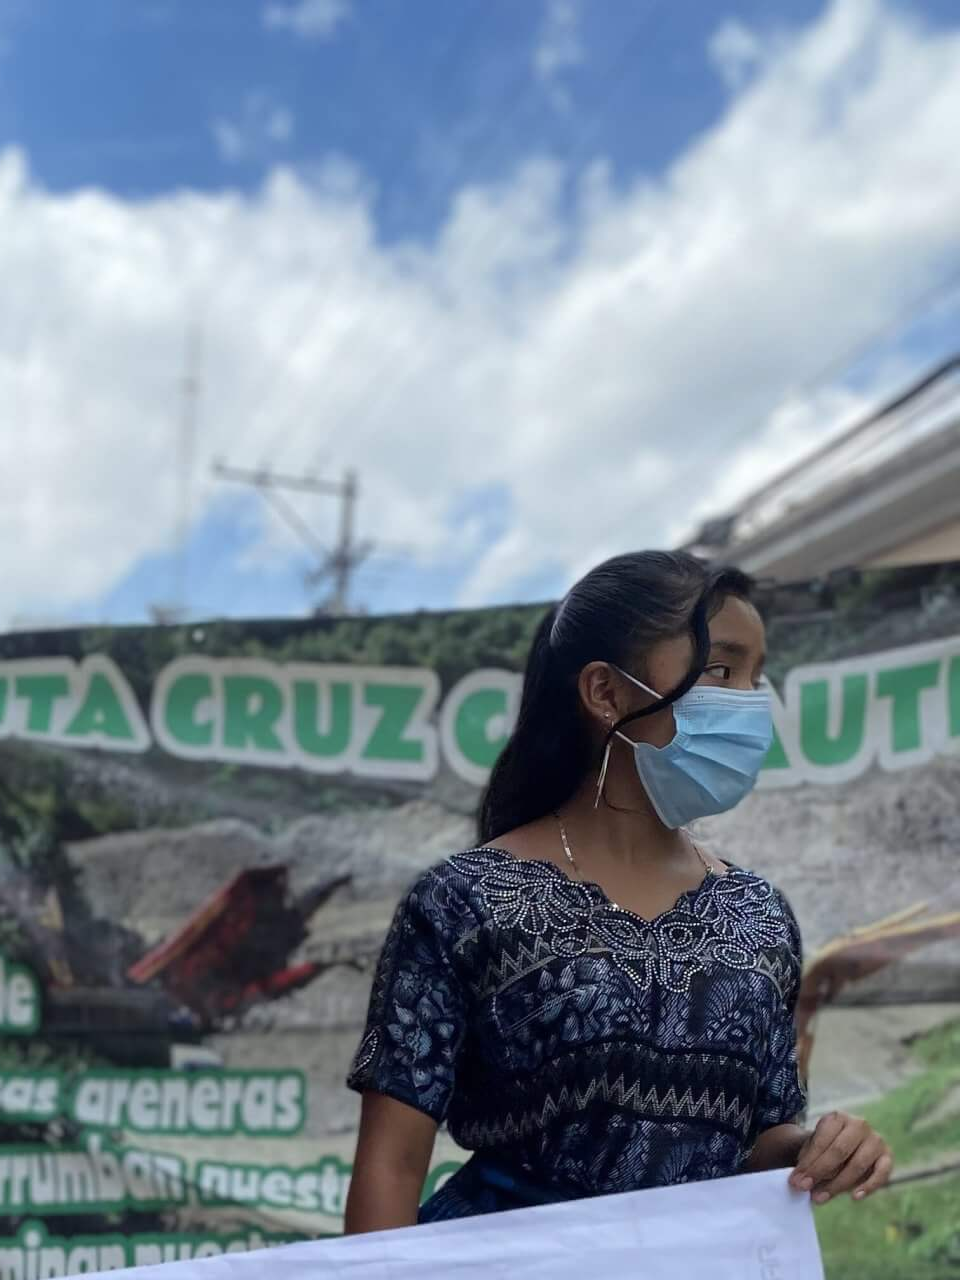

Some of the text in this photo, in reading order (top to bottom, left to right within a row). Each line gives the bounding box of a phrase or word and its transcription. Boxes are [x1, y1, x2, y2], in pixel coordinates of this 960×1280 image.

[161, 669, 429, 764] CRUZ
[73, 1074, 303, 1130] areneras
[200, 1163, 352, 1213] nuest
